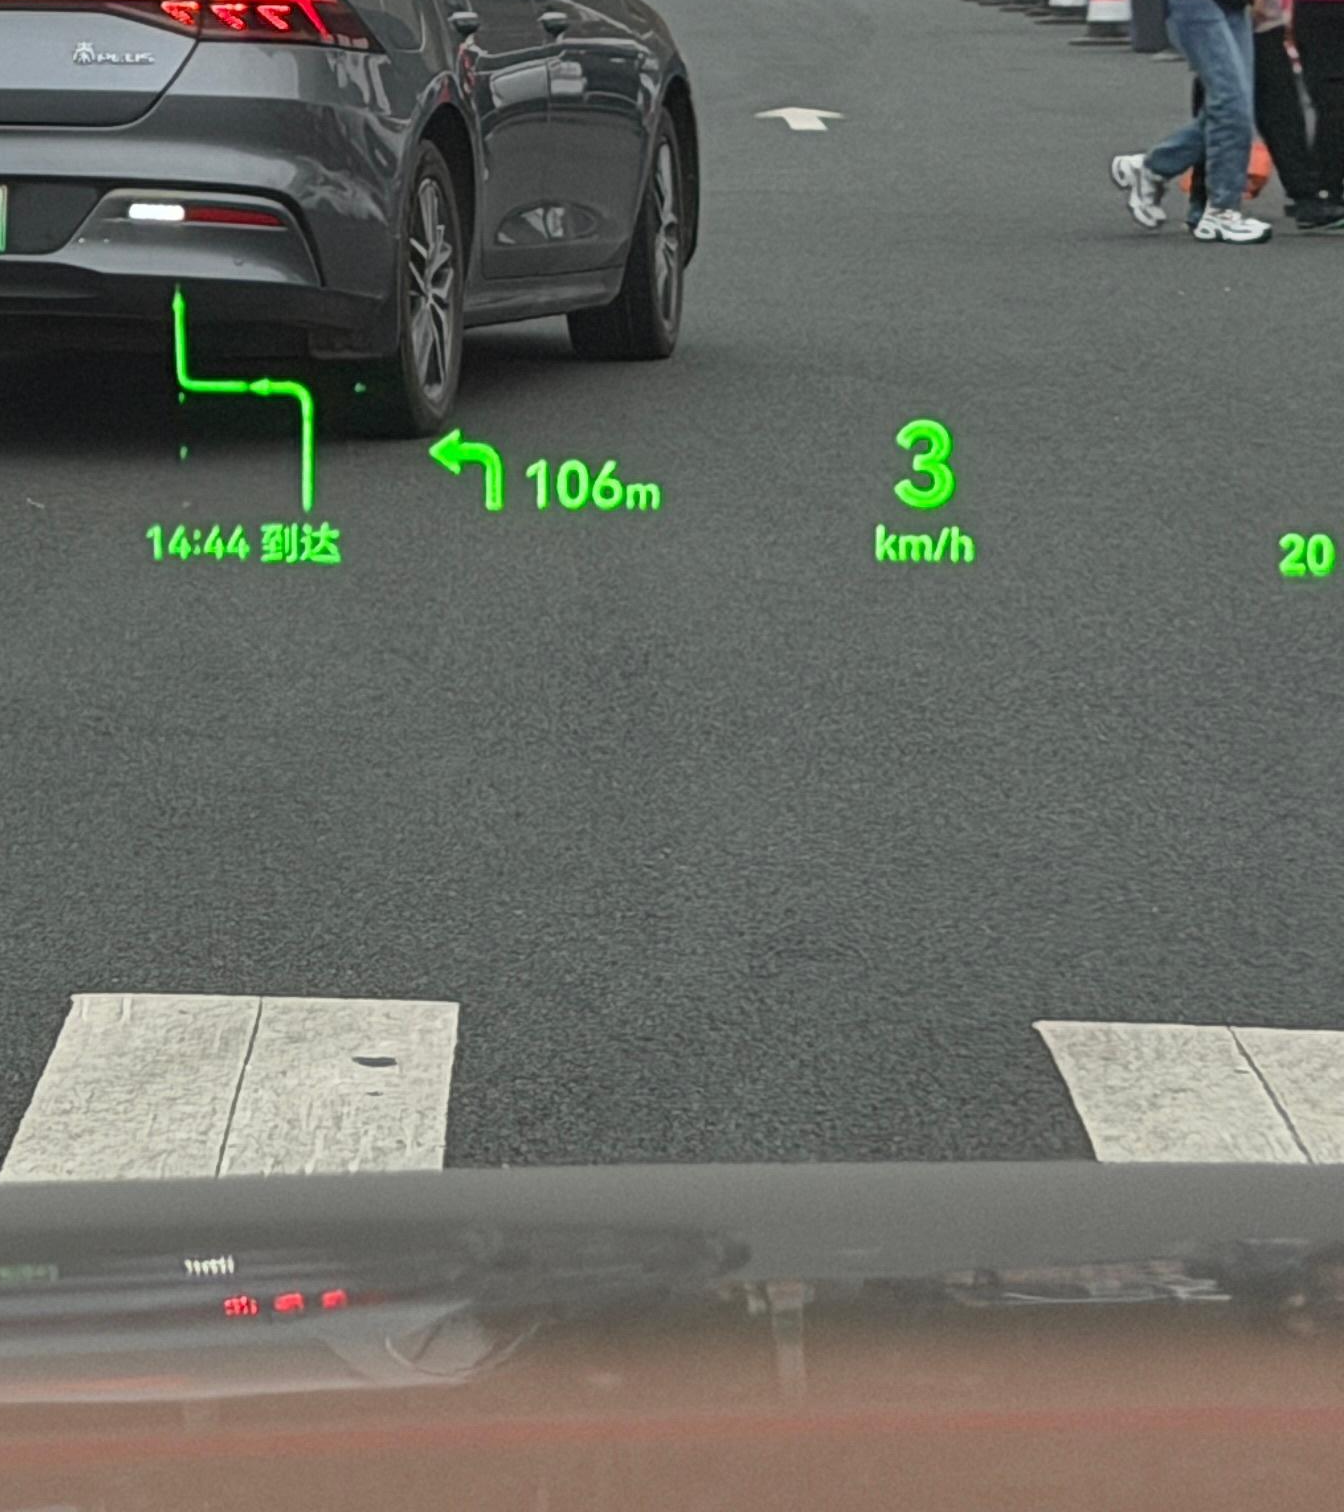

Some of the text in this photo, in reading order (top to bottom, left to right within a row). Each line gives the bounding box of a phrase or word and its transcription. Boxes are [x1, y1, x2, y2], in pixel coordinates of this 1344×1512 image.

[525, 458, 661, 512] 106m
[894, 419, 957, 510] 3
[145, 522, 342, 565] 14:44 到达
[874, 524, 975, 563] km/h
[1277, 533, 1336, 578] 20
